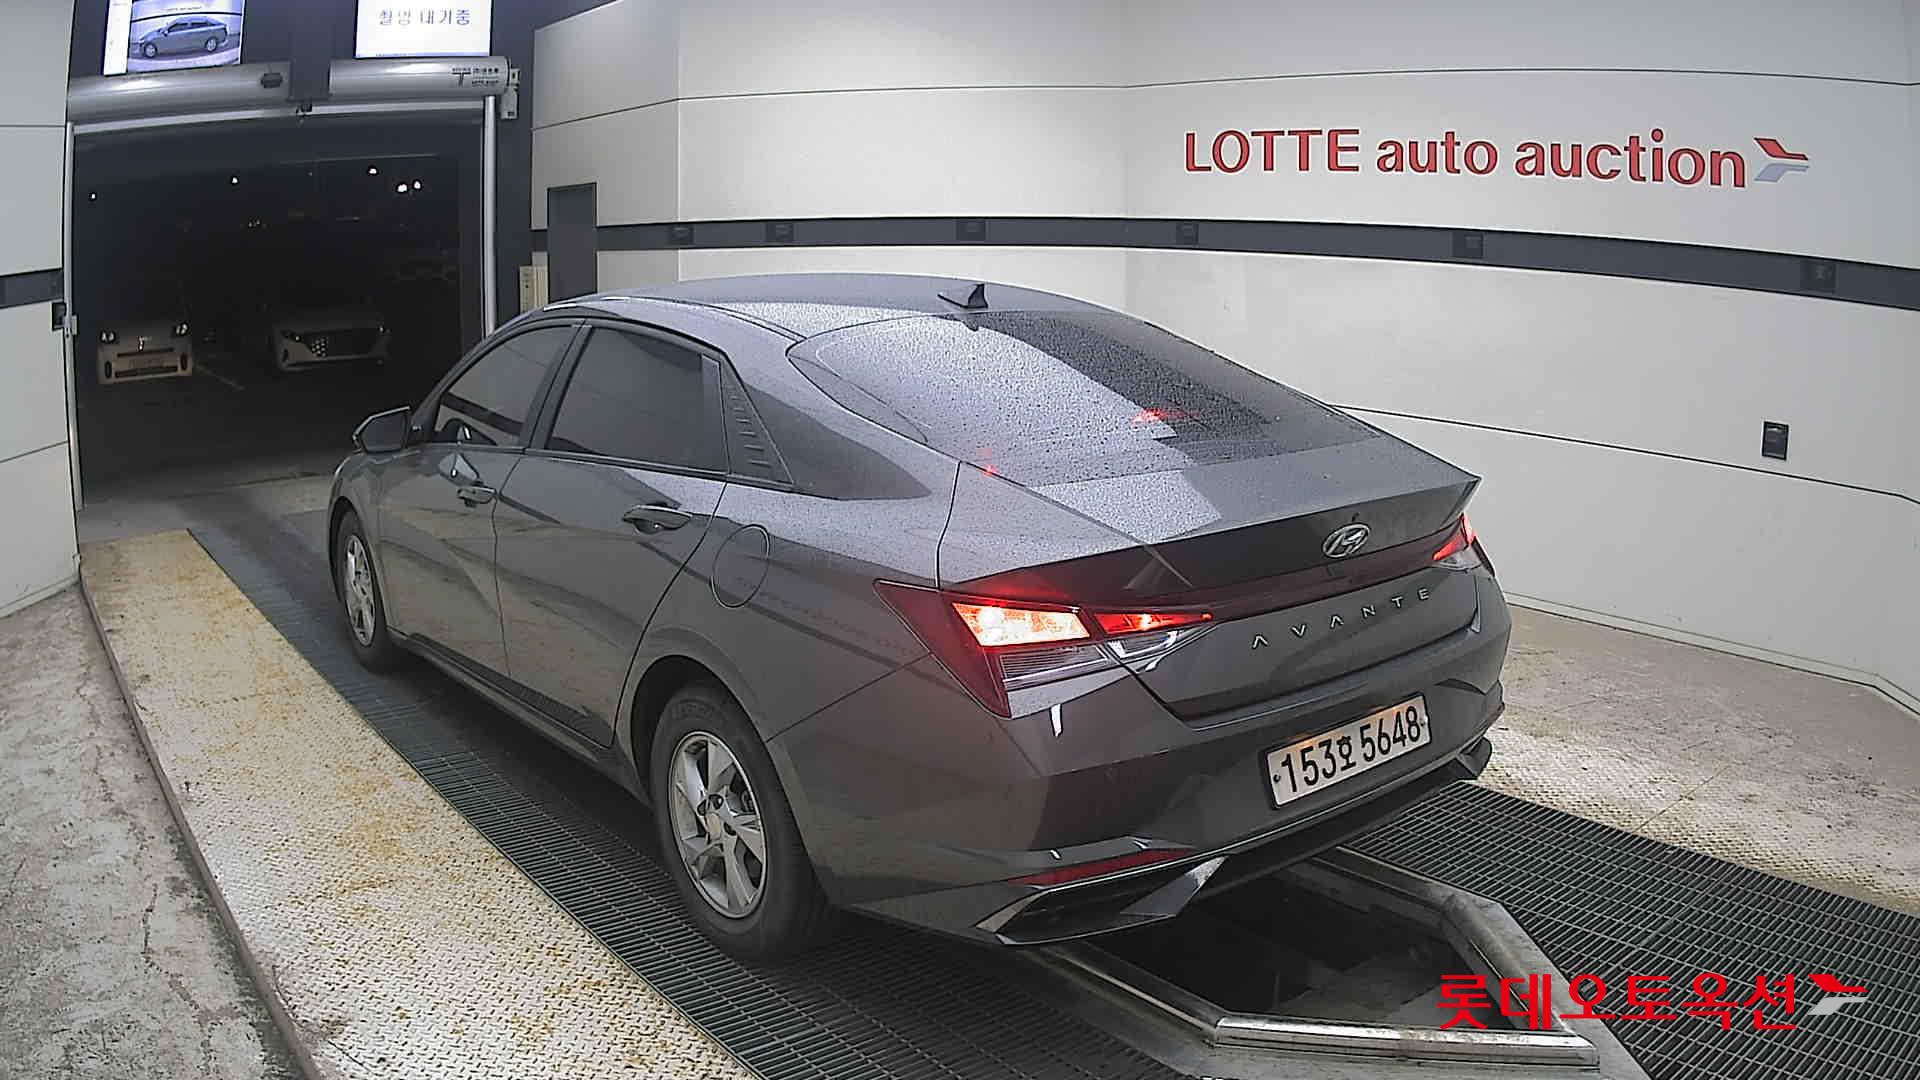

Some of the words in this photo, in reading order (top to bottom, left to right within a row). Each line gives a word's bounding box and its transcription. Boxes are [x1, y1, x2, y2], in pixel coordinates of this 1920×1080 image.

[419, 8, 471, 26] 대기중
[1185, 129, 1360, 173] LOTTE
[1376, 131, 1498, 176] auto
[1515, 129, 1747, 188] auction
[1251, 586, 1431, 649] AVANTE
[1281, 735, 1357, 793] 153호
[1359, 706, 1421, 762] 5648
